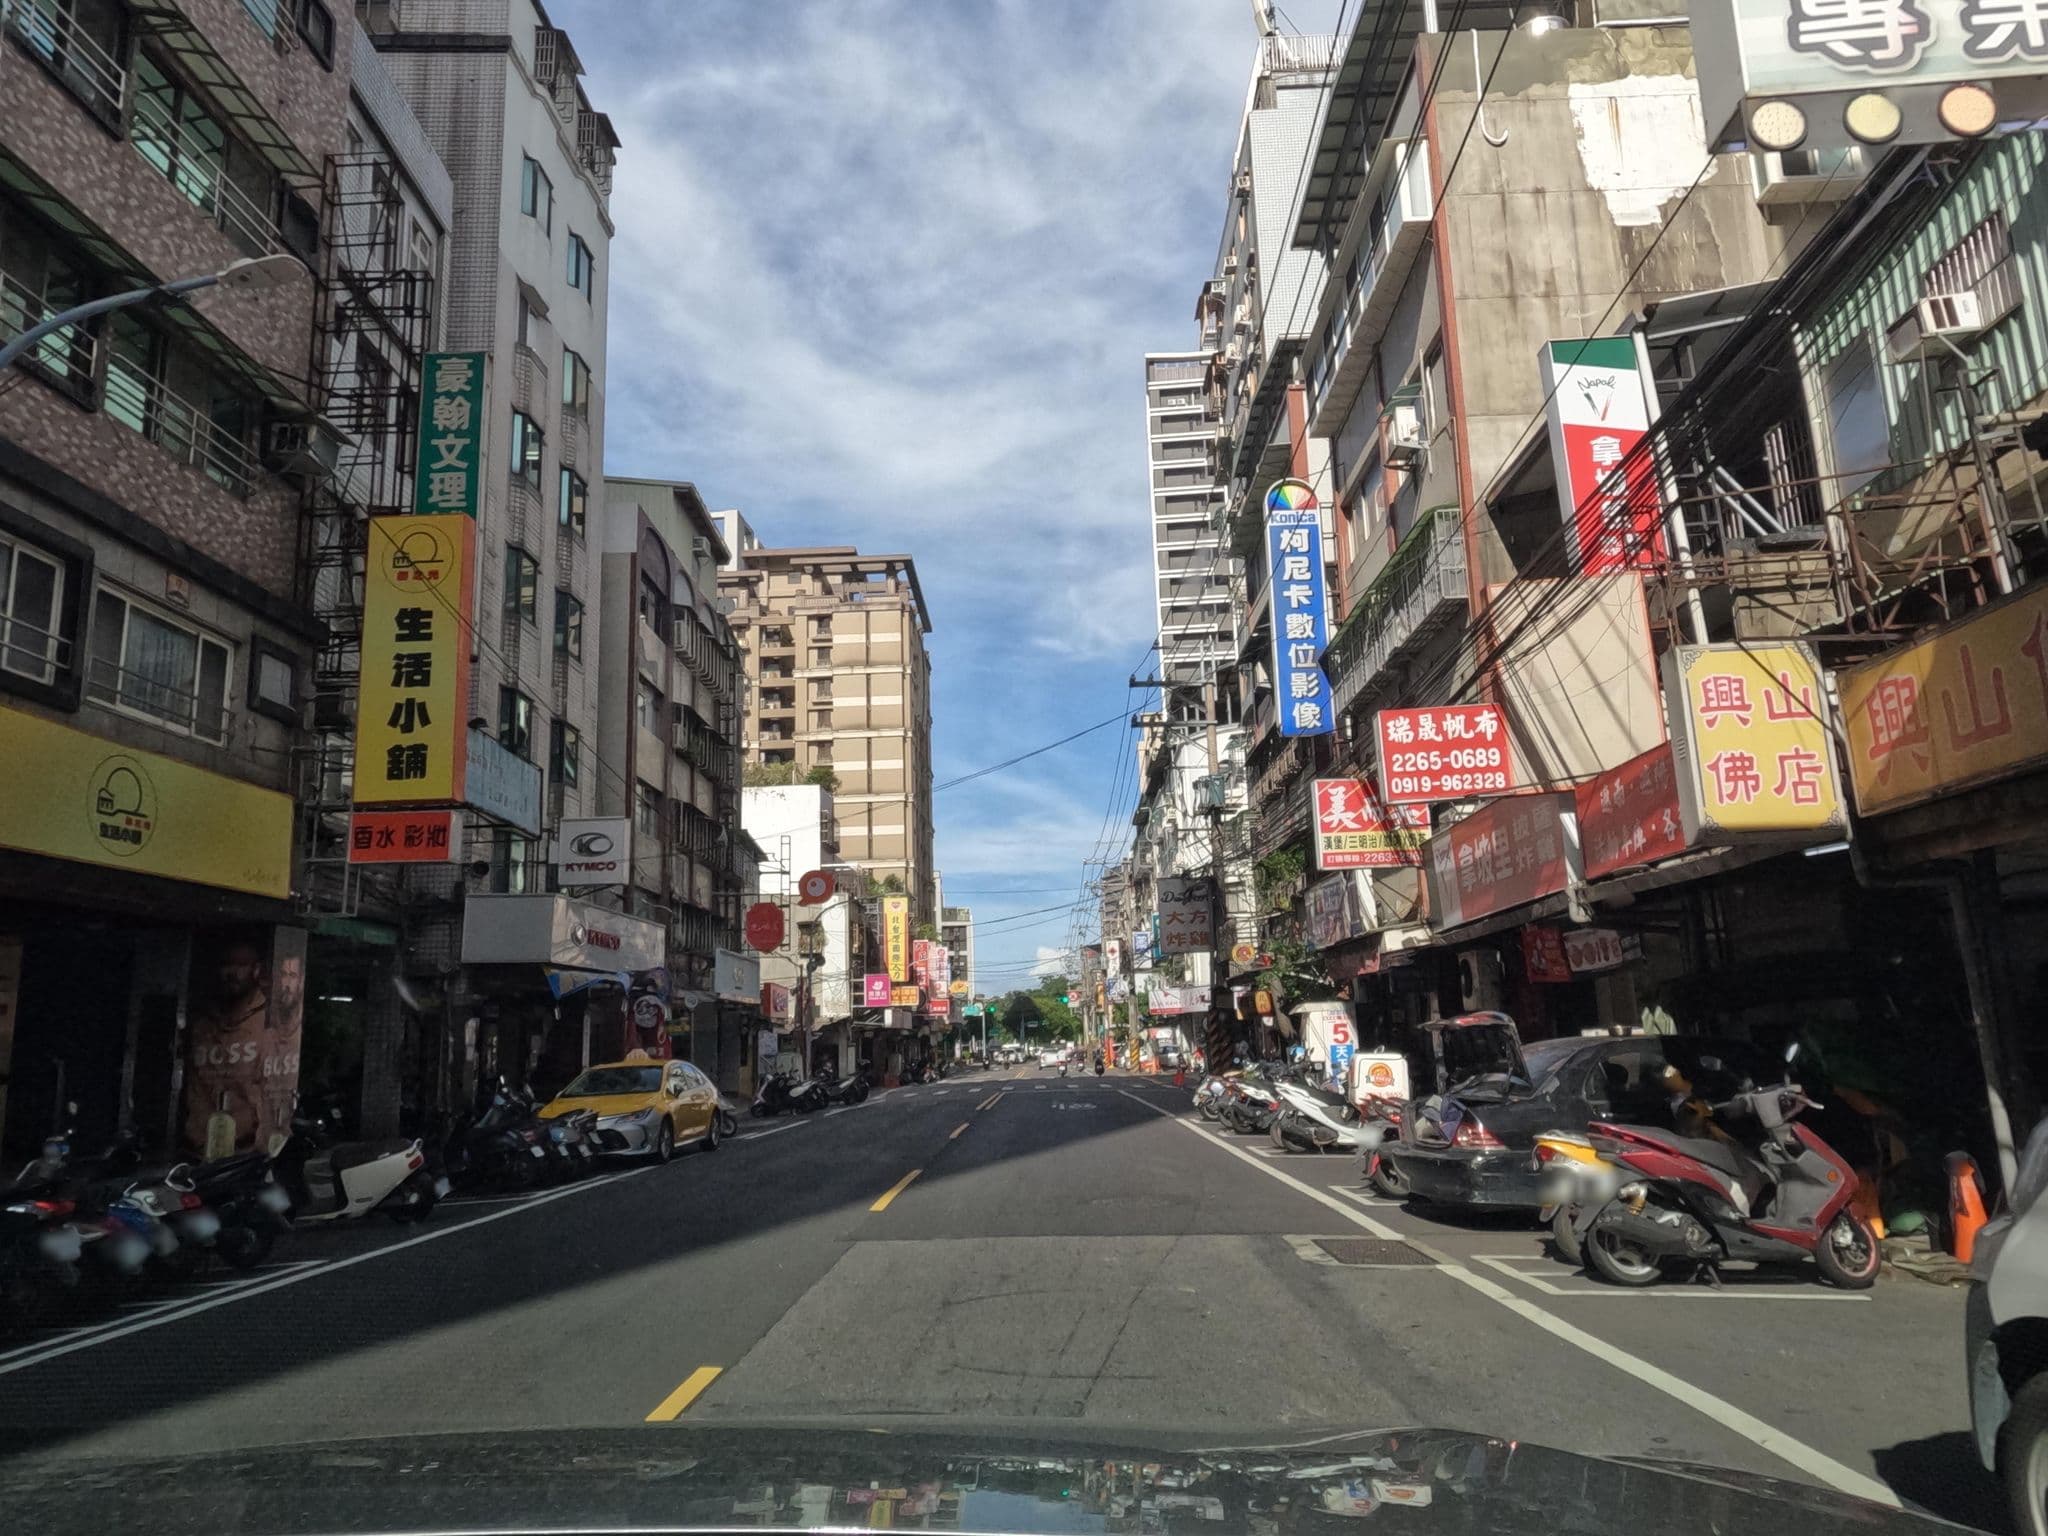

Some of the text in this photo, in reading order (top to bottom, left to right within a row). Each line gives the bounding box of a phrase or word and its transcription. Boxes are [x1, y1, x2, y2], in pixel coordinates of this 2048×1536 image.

[1270, 511, 1317, 524] Konica
[1279, 528, 1323, 730] 柯尼卡數位影像
[1700, 673, 1813, 728] 興山
[1387, 710, 1499, 744] 瑞晟帆布
[1392, 748, 1501, 773] 2265-0689
[1391, 772, 1506, 794] 0919-962328
[1707, 748, 1824, 806] 佛店
[565, 861, 616, 872] KYMCO
[1166, 910, 1208, 924] 大方
[1333, 1023, 1349, 1043] 5
